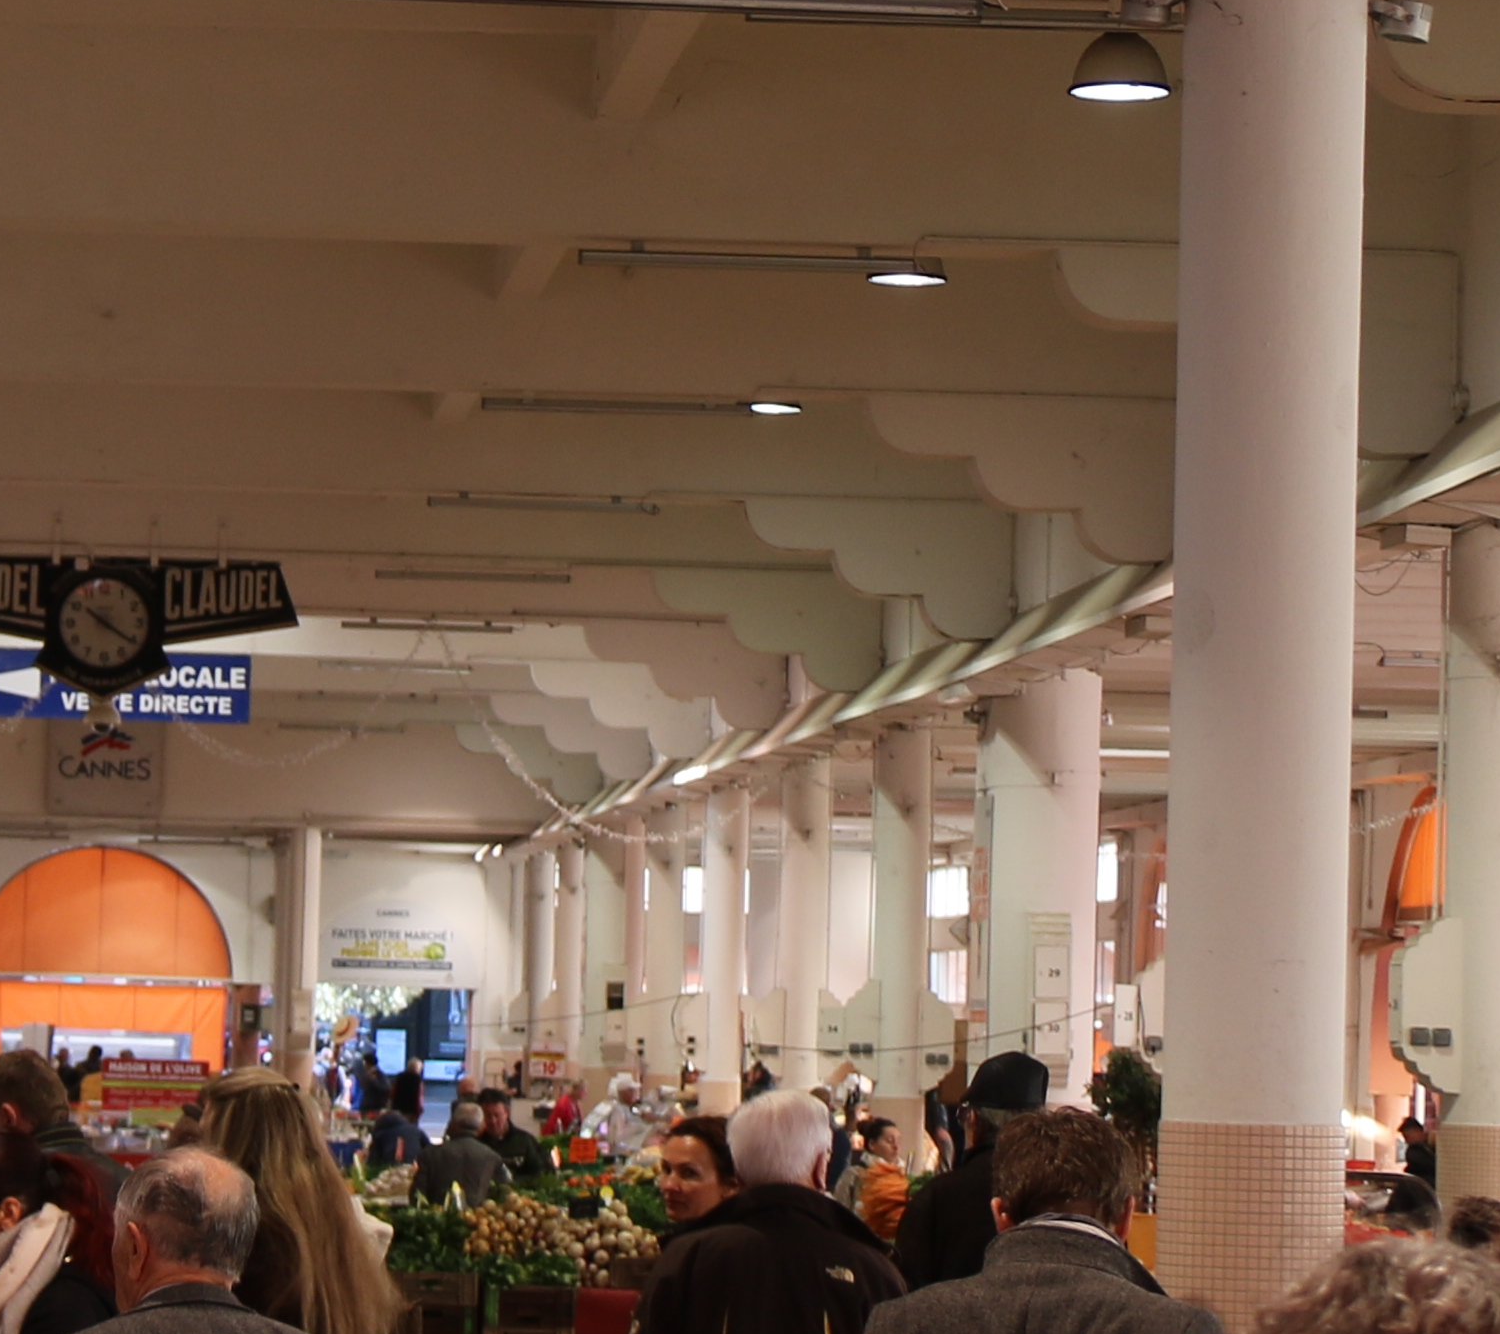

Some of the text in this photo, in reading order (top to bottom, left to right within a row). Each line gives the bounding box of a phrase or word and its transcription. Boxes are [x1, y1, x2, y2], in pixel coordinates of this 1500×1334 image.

[164, 567, 283, 620] CLAUDEL
[61, 691, 233, 715] VEE DIRECTE
[59, 754, 151, 780] CANNES
[331, 928, 367, 939] FAITES
[369, 929, 402, 939] VOTRE
[1047, 968, 1061, 978] 29
[109, 1060, 203, 1075] MAISON DE L'OLIVE
